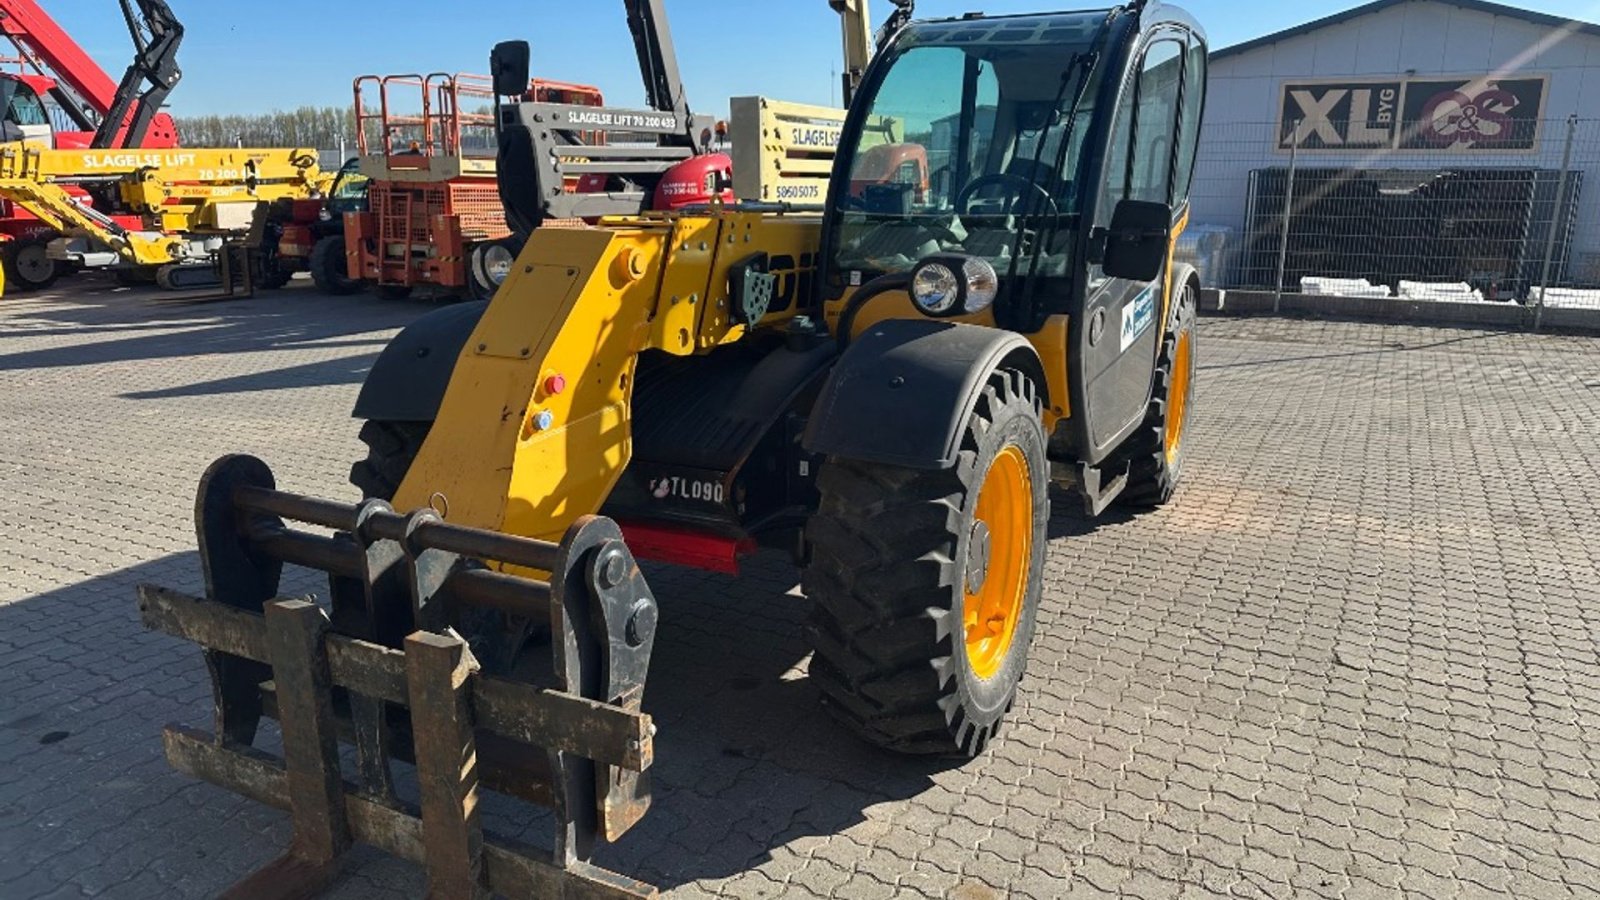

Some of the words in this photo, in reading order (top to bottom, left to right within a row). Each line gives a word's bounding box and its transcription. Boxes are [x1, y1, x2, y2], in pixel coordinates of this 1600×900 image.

[1283, 88, 1390, 145] XL
[1377, 89, 1394, 122] BYG
[568, 111, 612, 125] SLAGELSE
[613, 114, 632, 126] LIFT
[633, 116, 644, 126] 70
[83, 154, 161, 168] SLAGELSE
[165, 153, 196, 167] LIFT
